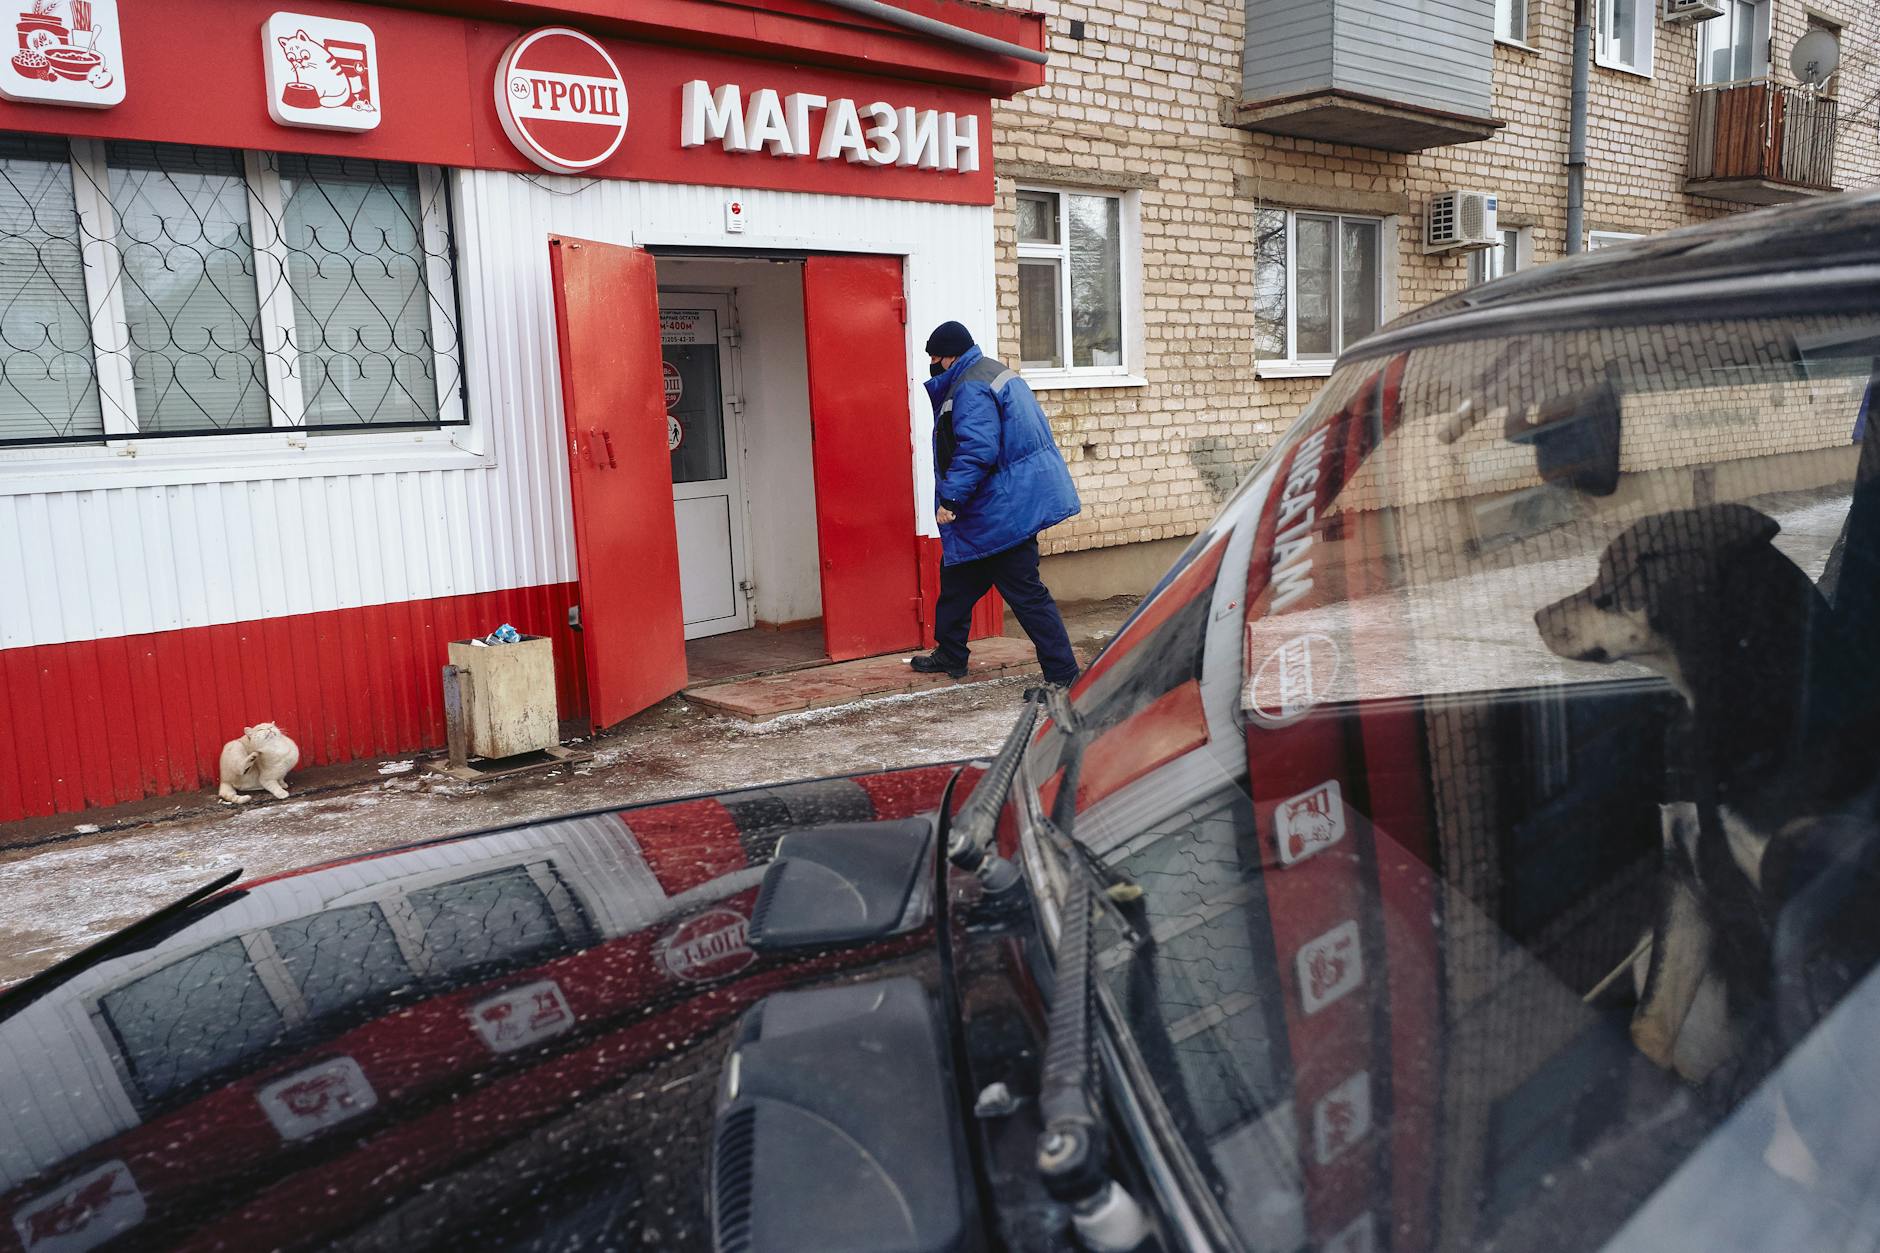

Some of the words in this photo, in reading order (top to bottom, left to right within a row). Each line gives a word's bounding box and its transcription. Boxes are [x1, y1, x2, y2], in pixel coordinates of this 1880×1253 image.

[513, 83, 527, 94] ЗА
[530, 79, 620, 117] ГРОШ
[681, 79, 980, 174] МАГАЗИН
